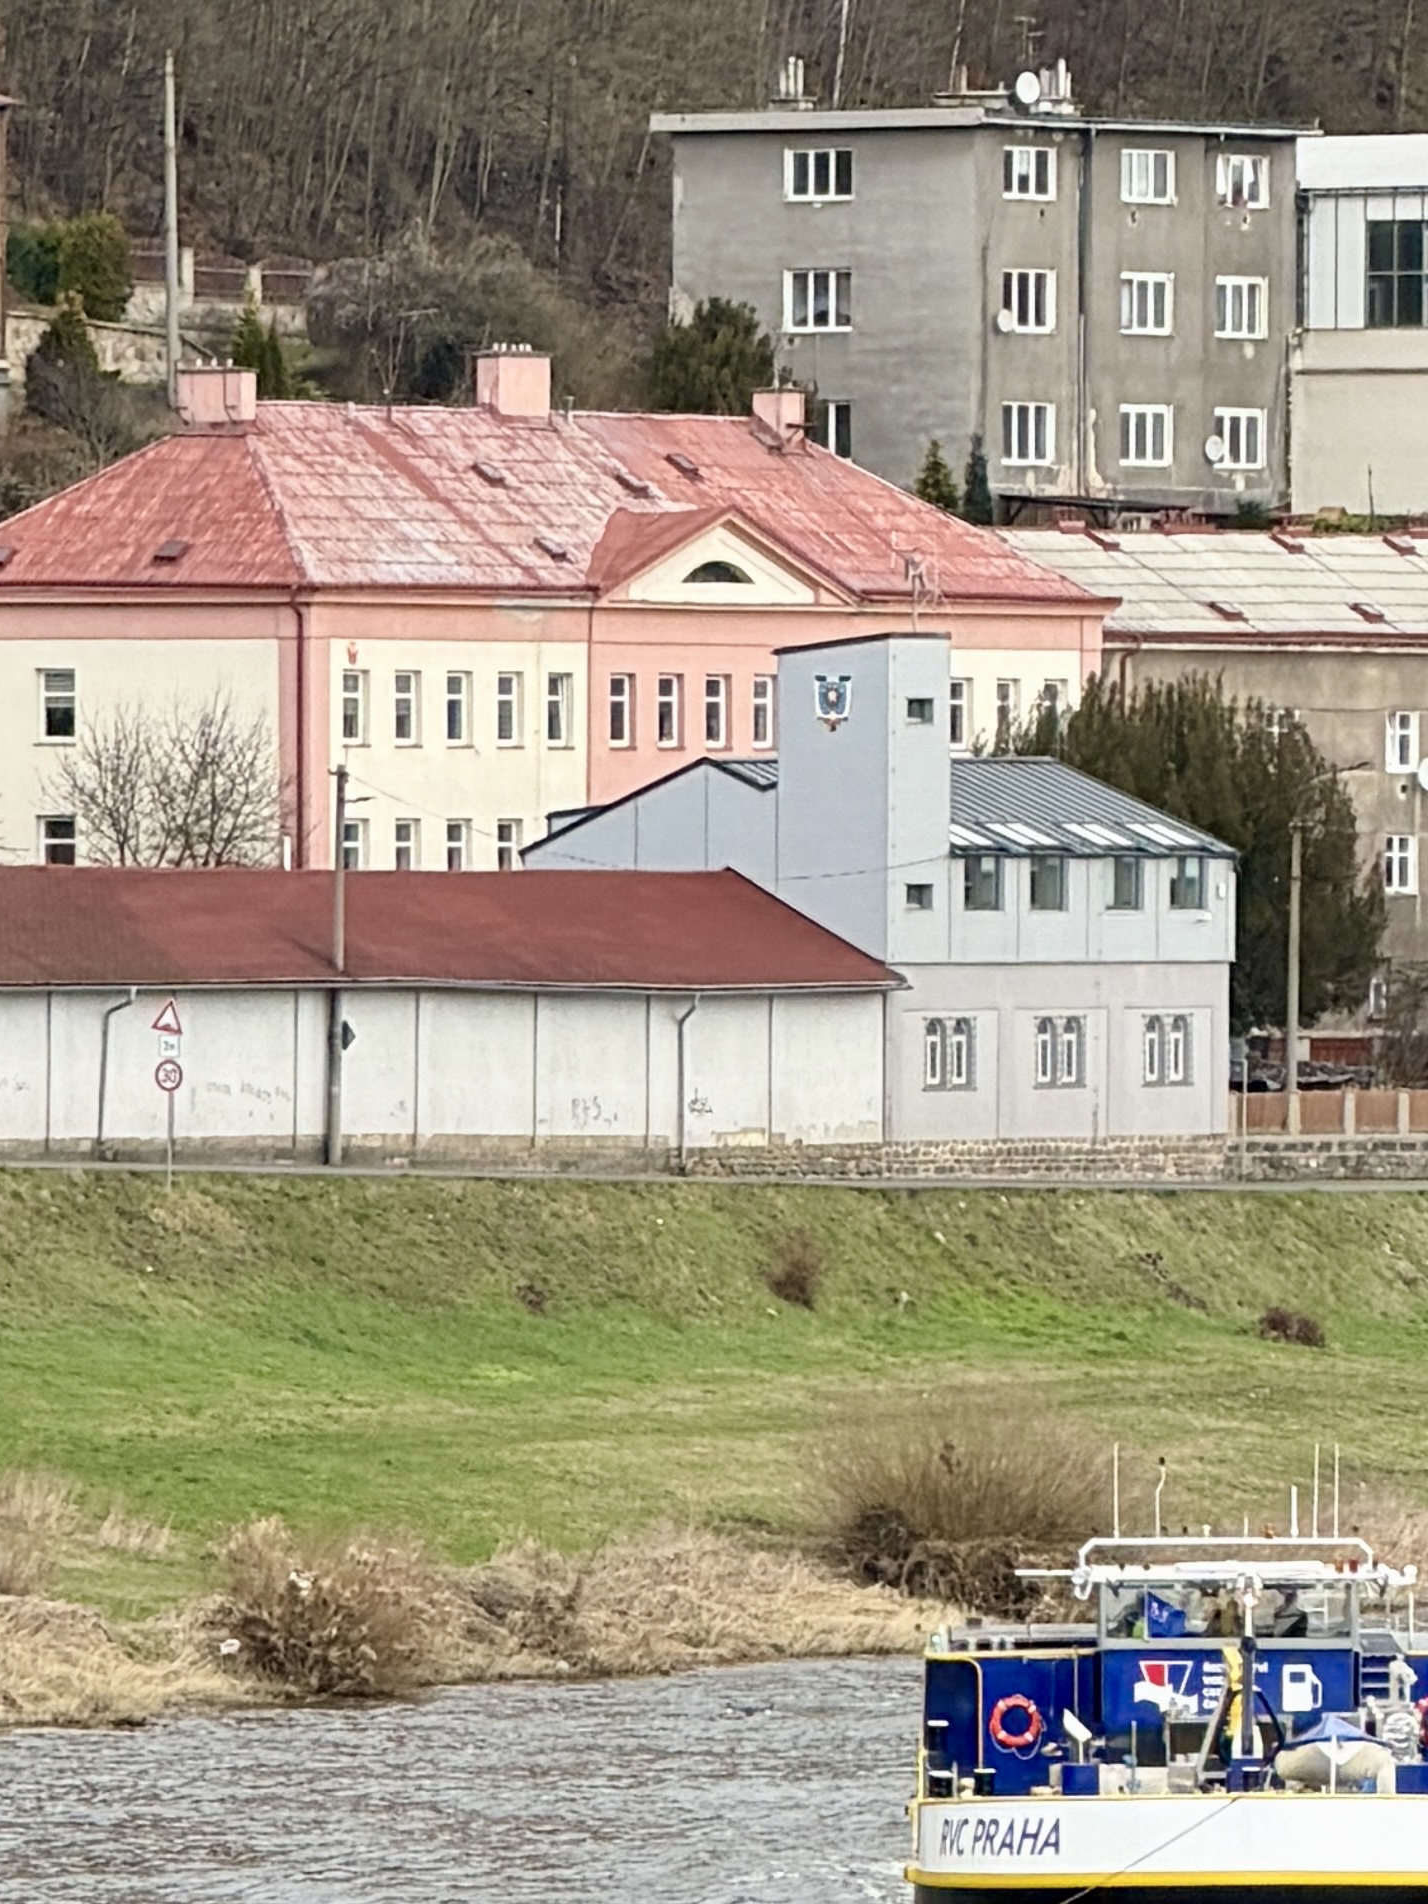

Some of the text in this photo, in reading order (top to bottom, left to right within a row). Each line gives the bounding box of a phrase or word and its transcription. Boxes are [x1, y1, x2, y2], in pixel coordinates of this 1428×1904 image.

[162, 1068, 177, 1083] 30
[939, 1818, 1060, 1856] RVC PRAHA
